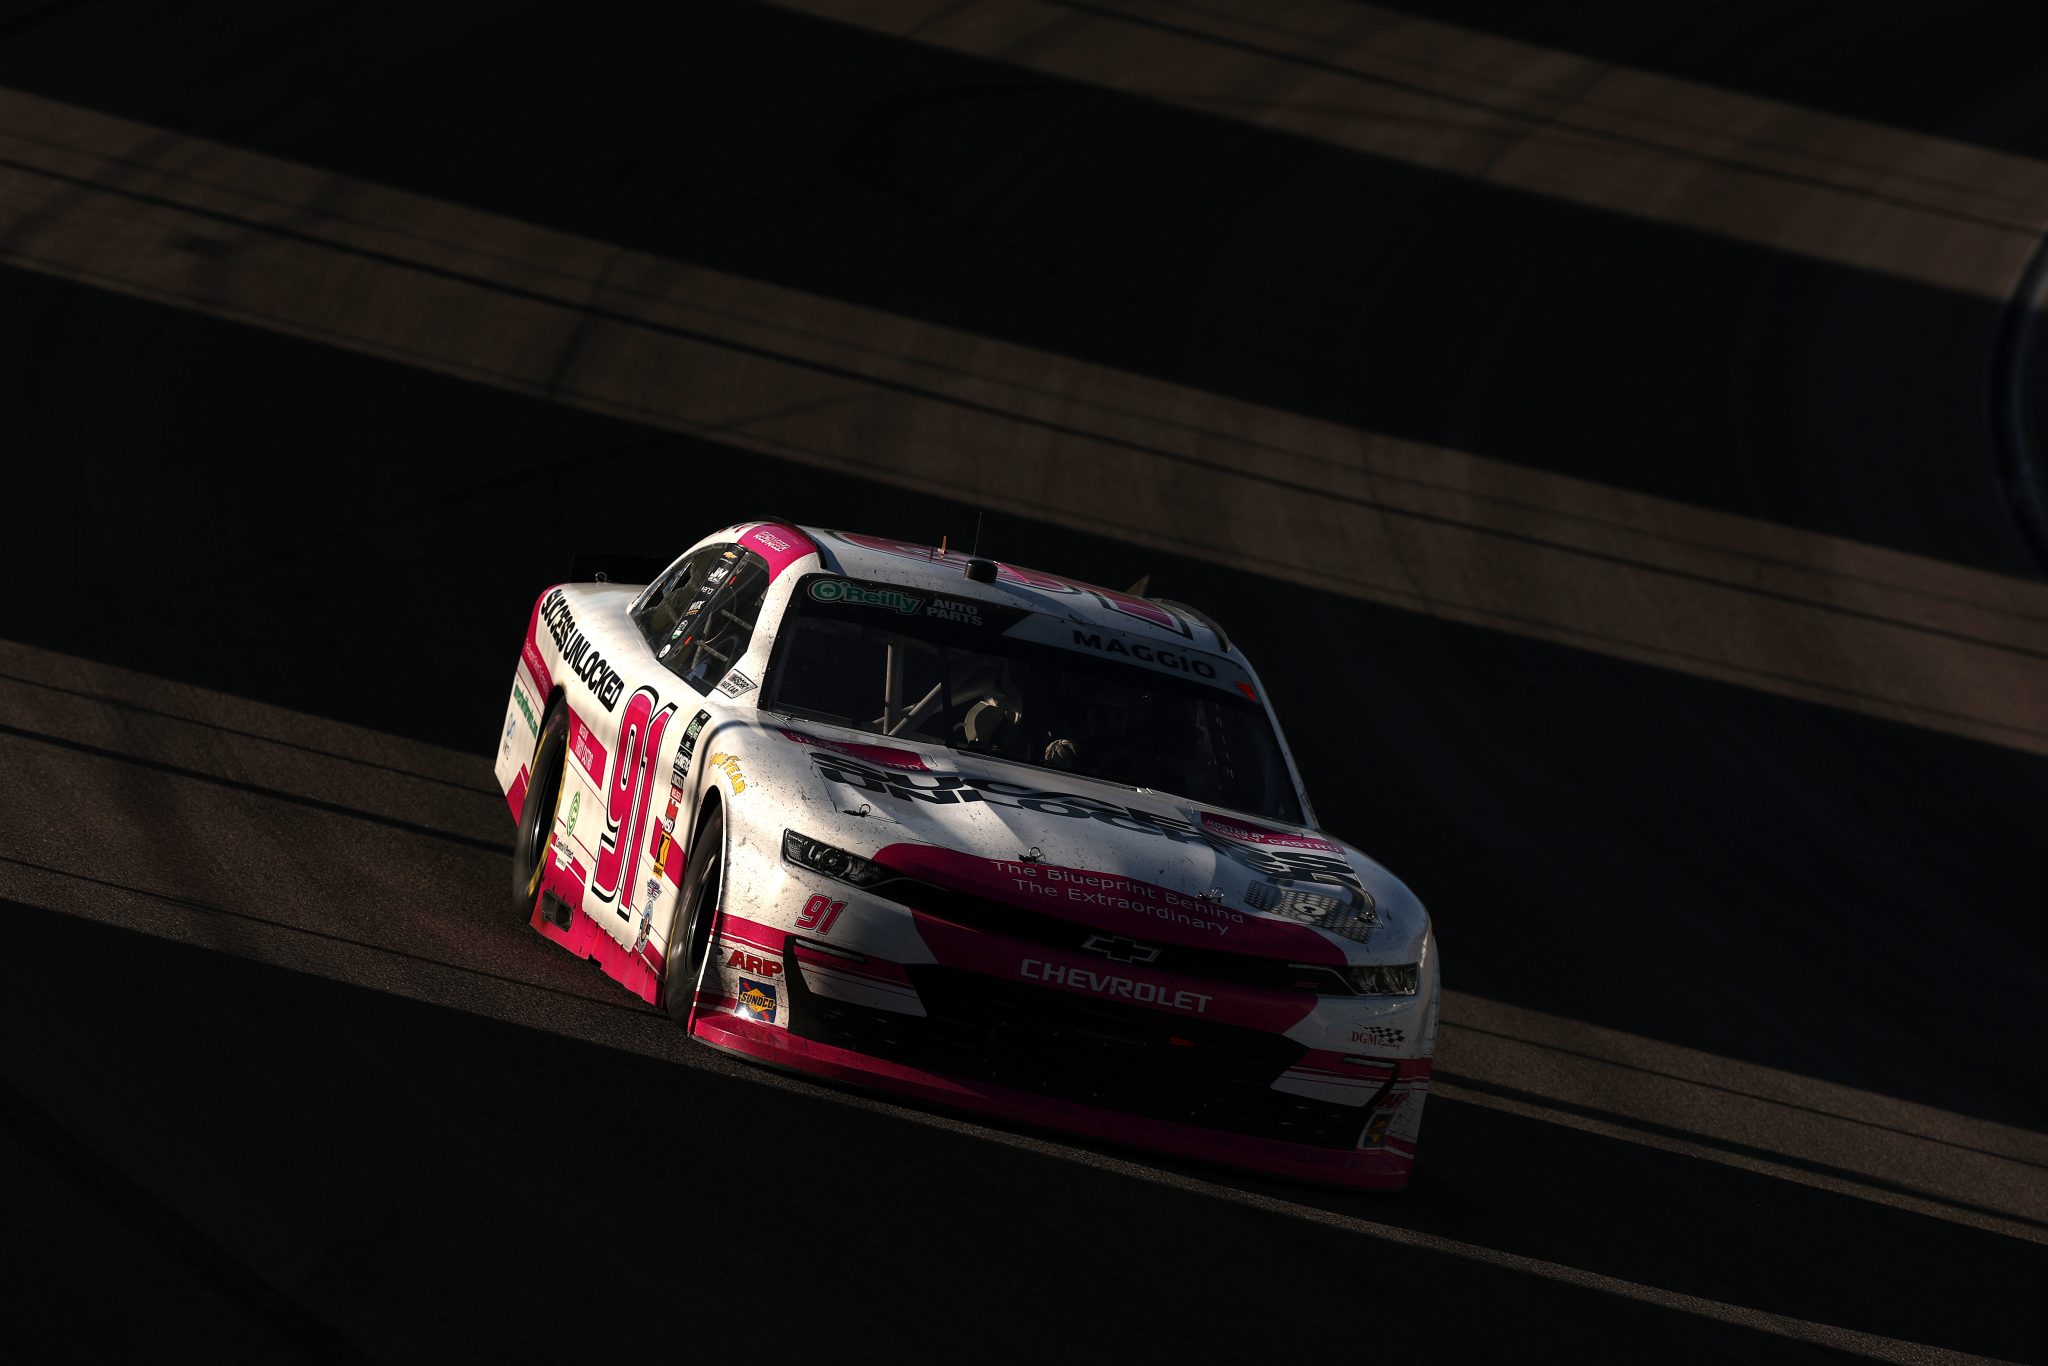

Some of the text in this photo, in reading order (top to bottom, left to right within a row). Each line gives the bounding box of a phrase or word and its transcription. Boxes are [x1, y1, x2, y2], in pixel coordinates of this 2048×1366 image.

[811, 579, 922, 614] O'Reilly
[926, 607, 984, 627] PARTS
[931, 599, 978, 615] AUTO
[563, 629, 625, 713] UNLOCKED
[1073, 629, 1216, 679] MAGGIO
[708, 752, 746, 796] YEAR
[591, 686, 678, 923] 91
[796, 893, 848, 935] 91
[990, 861, 1244, 924] The Blueprint Behind
[1012, 879, 1230, 936] The Extraordinary
[726, 950, 783, 977] ARP
[1020, 958, 1213, 1013] CHEVROLET
[740, 992, 775, 1009] SUNOCO
